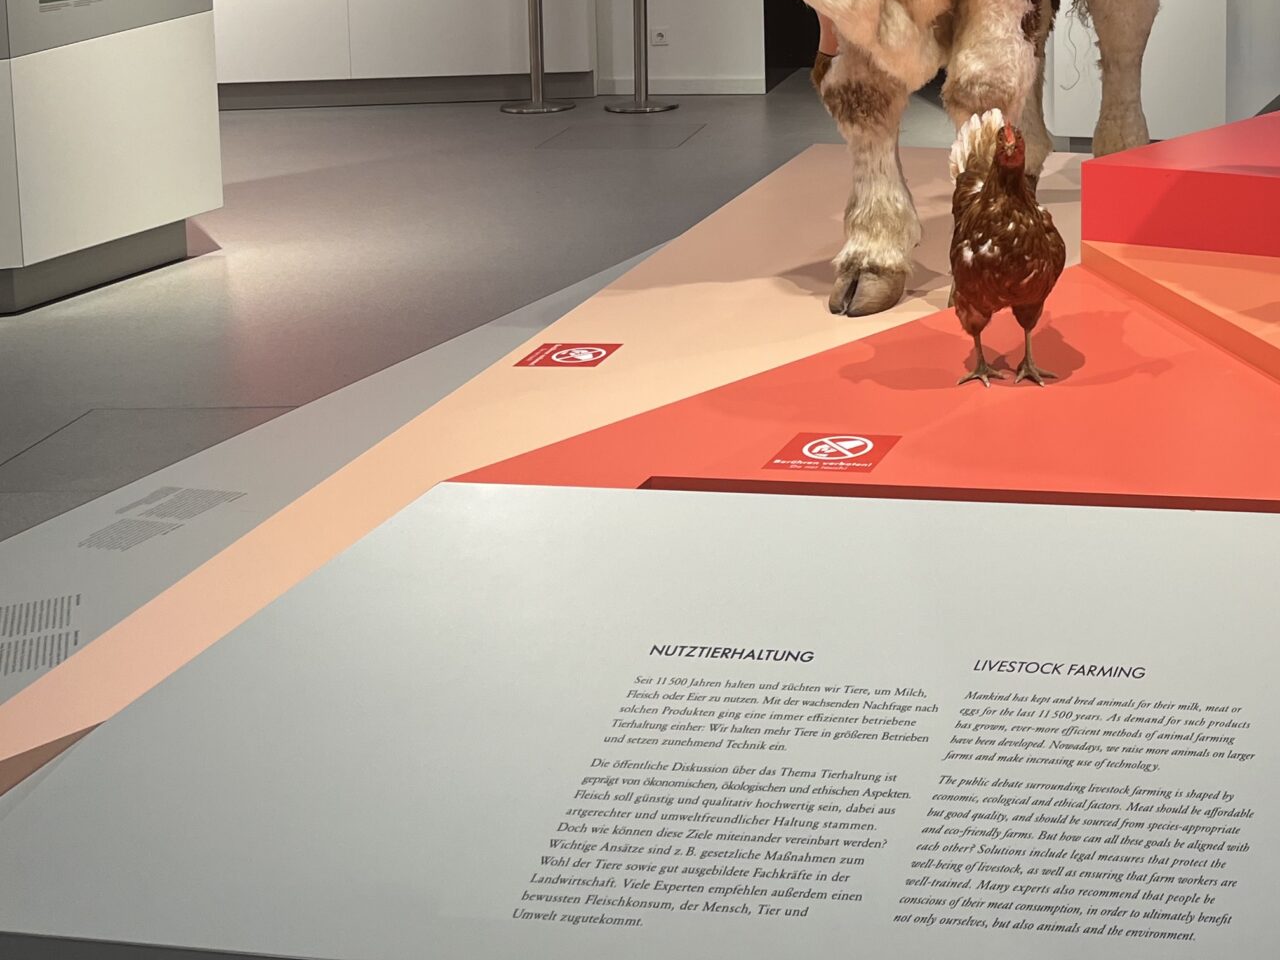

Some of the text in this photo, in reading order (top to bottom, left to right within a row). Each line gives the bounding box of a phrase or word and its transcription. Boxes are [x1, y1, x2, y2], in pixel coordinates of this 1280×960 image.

[649, 644, 814, 663] NUTZTIERHALTUNG
[973, 659, 1146, 679] LIVESTOCK FARMING
[626, 689, 660, 699] Fleisch
[662, 691, 685, 701] oder
[686, 692, 708, 701] Eier
[723, 696, 759, 704] nutzen.
[762, 696, 782, 705] Mit
[783, 696, 800, 706] der
[802, 698, 860, 709] wachsenden
[862, 700, 913, 713] Nachfrage
[914, 704, 939, 713] nach
[964, 691, 1012, 701] Mankind
[1011, 693, 1029, 702] has
[1030, 694, 1051, 705] kept
[1052, 696, 1074, 705] and
[1073, 696, 1096, 706] bred
[1096, 698, 1136, 708] animals
[1134, 700, 1152, 710] for
[1153, 700, 1176, 710] their
[1177, 702, 1202, 712] milk,
[619, 704, 659, 714] solchen
[661, 706, 715, 717] Produkten
[717, 711, 742, 720] ging
[769, 713, 804, 721] immer
[806, 713, 860, 724] effizienter
[861, 715, 917, 727] betriebene
[603, 734, 787, 751] und setzen zunehmend Technik ein.
[954, 720, 1236, 745] has grown, ever-more efficient methods of animal farming
[581, 776, 620, 787] geprägt
[643, 777, 718, 791] ökonomischen,
[721, 780, 786, 794] ökologischen
[789, 784, 811, 794] und
[811, 785, 860, 797] ethischen
[862, 787, 911, 800] Aspekten.
[932, 794, 1255, 819] economic, ecological and ethical factors. Meat should be affordable
[565, 807, 877, 831] artgerechter und umweltfreundlicher Haltung stammen.
[916, 841, 1227, 869] each other? Solutions include legal measures that protect the
[530, 873, 863, 902] Landwirtschaft. Viele Experten empfehlen außerdem einen
[905, 876, 1216, 906] well-trained. Many experts also recommend that people be
[521, 890, 810, 917] bewussten Fleischkonsum, der Mensch, Tier und
[899, 896, 1232, 927] conscious of their meat consumption, in order to ultimately benefit
[512, 908, 643, 927] Umwelt zugutekommt.
[893, 913, 1195, 941] not only ourselves, but also animals and the environment.
